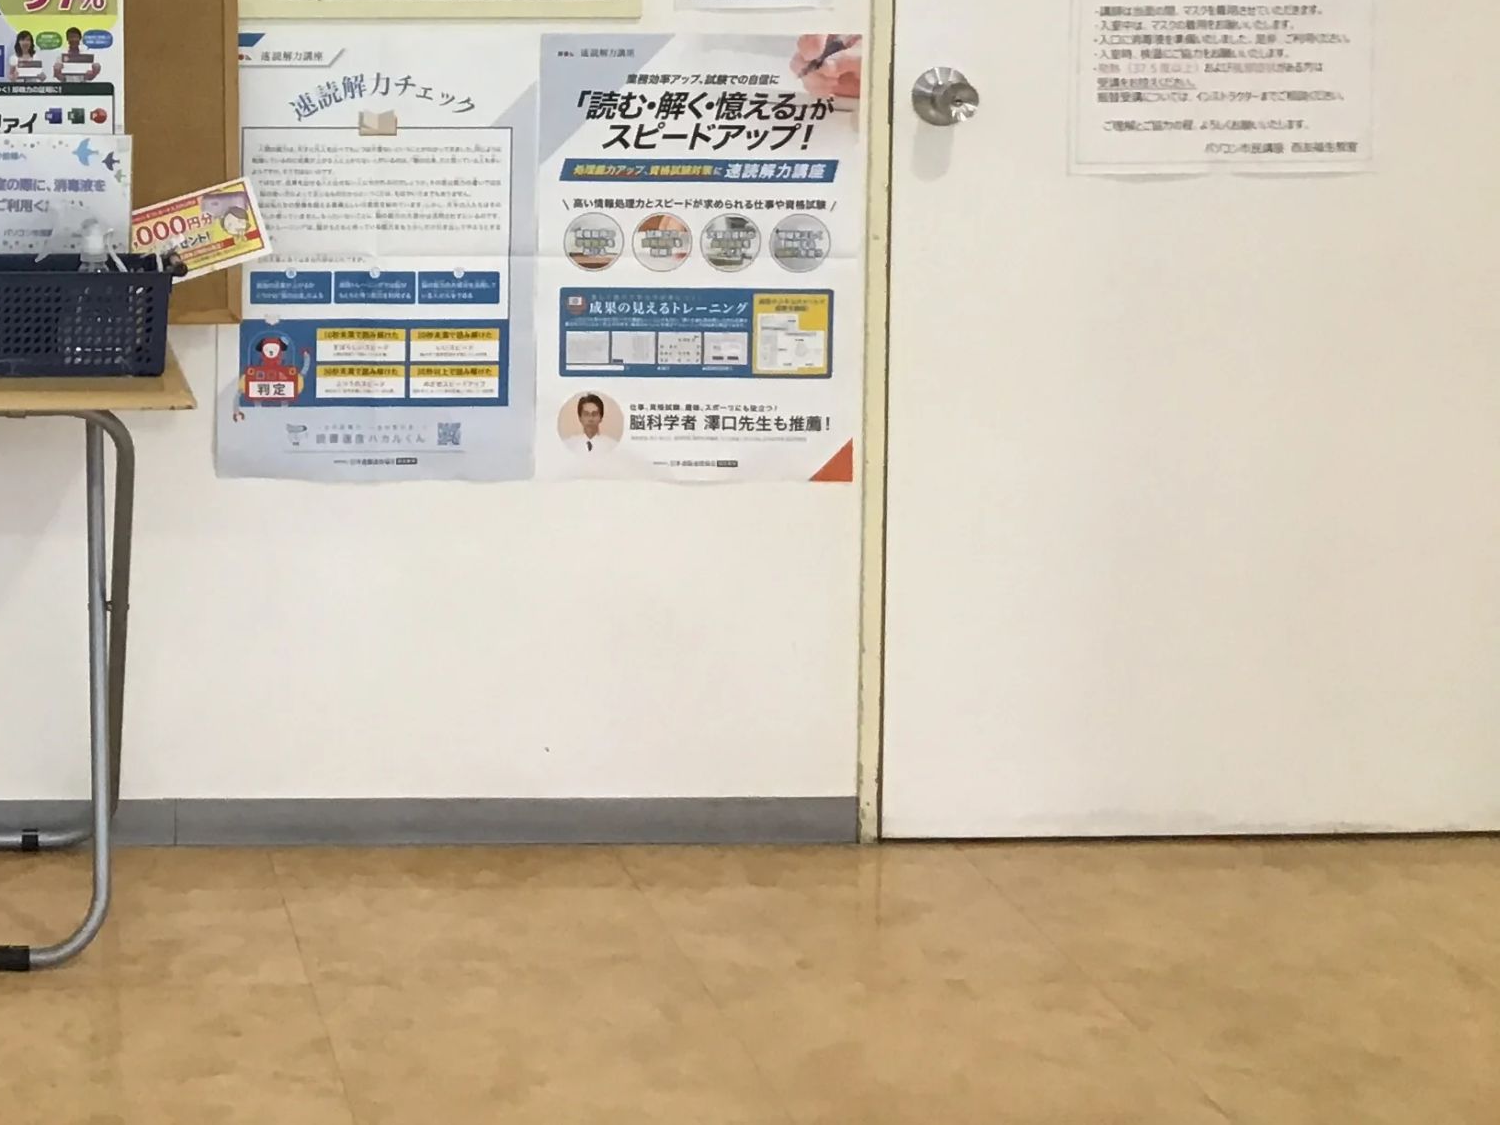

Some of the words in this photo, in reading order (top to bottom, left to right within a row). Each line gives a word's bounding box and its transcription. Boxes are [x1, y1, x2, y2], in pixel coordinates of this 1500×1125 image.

[625, 73, 780, 86] 業務効率アップ、試験での自信に
[288, 72, 476, 122] 速読解力チェック
[575, 90, 835, 122] 「読む・解く・憶える」が
[601, 121, 812, 151] スピードアップ!
[724, 162, 825, 181] 速読解力講座
[589, 301, 749, 315] 成果の見えるトレーニング
[256, 383, 286, 396] 判定
[629, 414, 697, 432] 脳科学者
[703, 414, 832, 433] 澤口先生も推薦!
